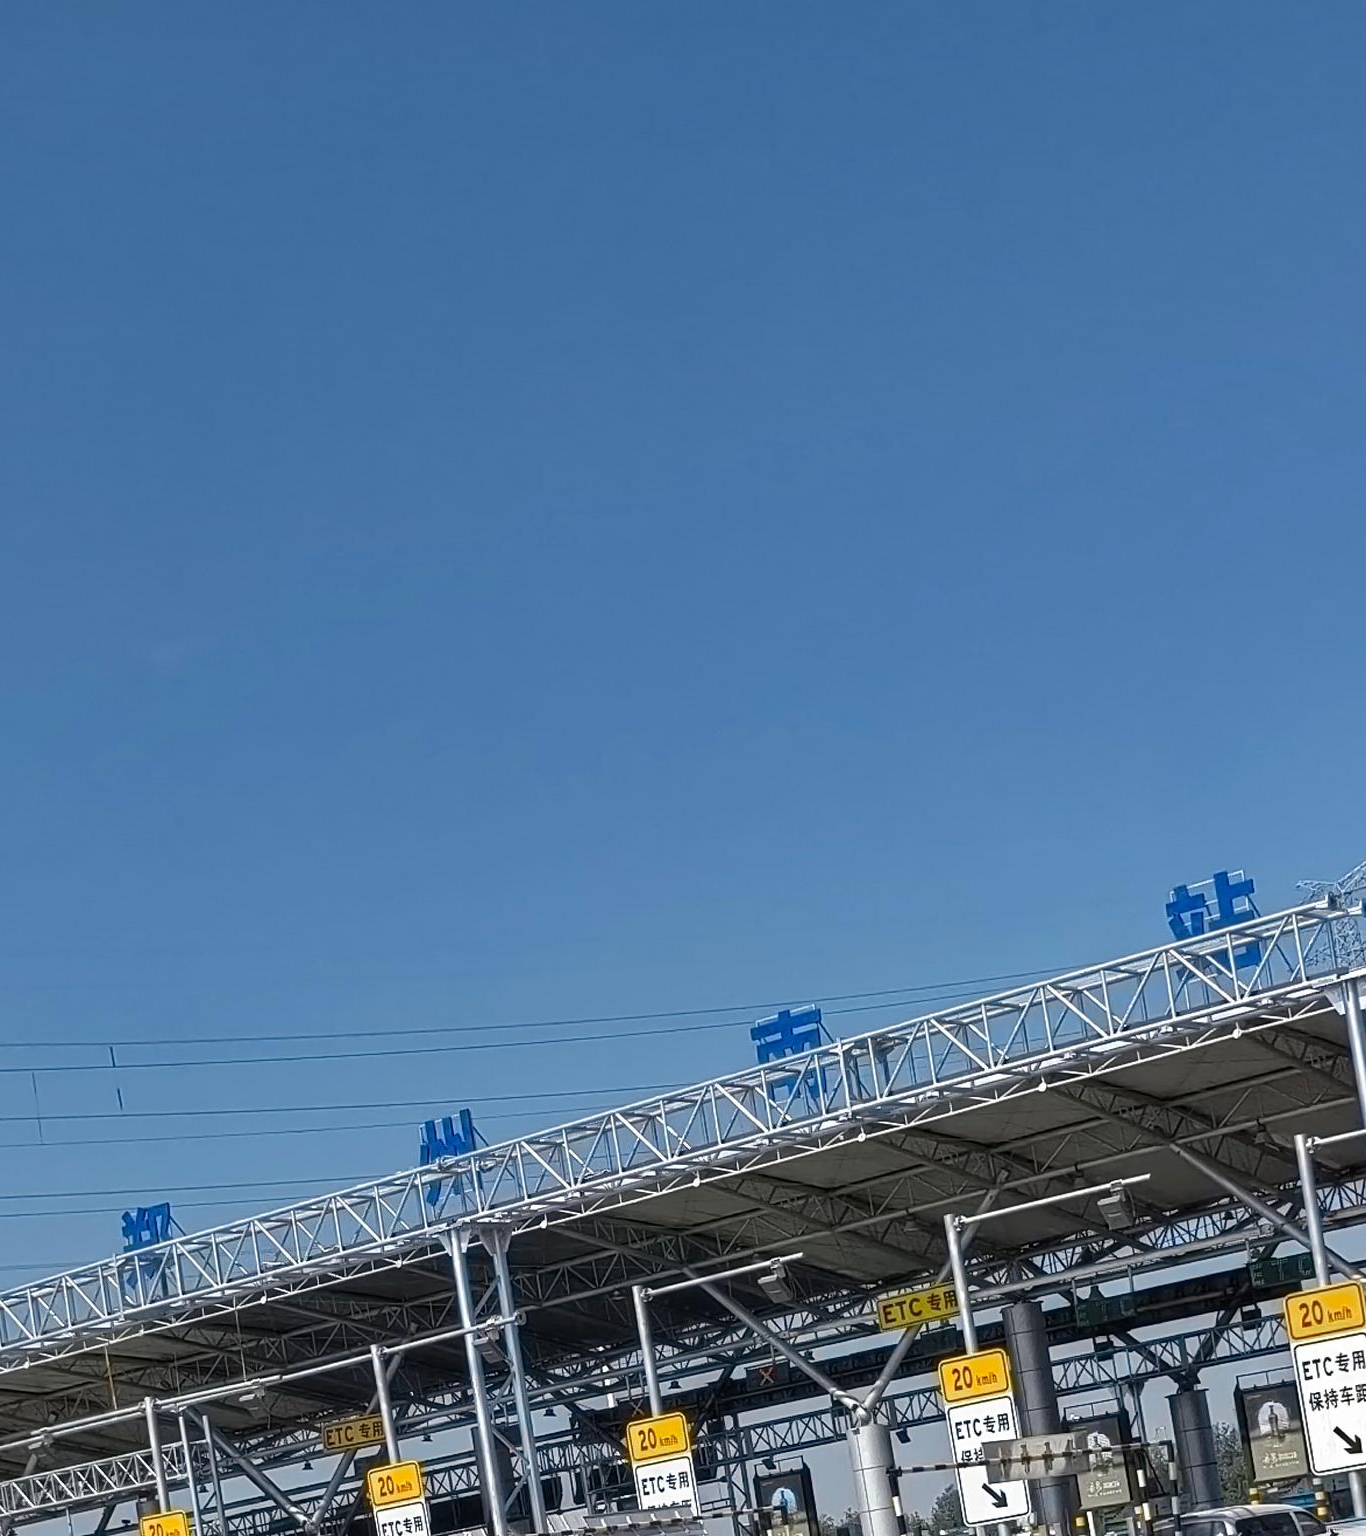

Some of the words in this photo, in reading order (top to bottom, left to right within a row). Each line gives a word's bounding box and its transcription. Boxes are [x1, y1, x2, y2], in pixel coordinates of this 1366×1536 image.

[882, 1297, 923, 1324] ETC
[926, 1289, 958, 1311] 专用
[1298, 1299, 1324, 1329] 20
[1327, 1306, 1354, 1324] km/h
[951, 1365, 973, 1392] 20
[976, 1372, 998, 1386] km/h
[1301, 1350, 1366, 1382] ETC专用
[326, 1425, 354, 1446] ETC
[638, 1427, 657, 1452] 20
[659, 1434, 678, 1447] km/h
[954, 1412, 1010, 1441] ETC专用
[377, 1474, 395, 1497] 20
[641, 1471, 690, 1496] ETC专用
